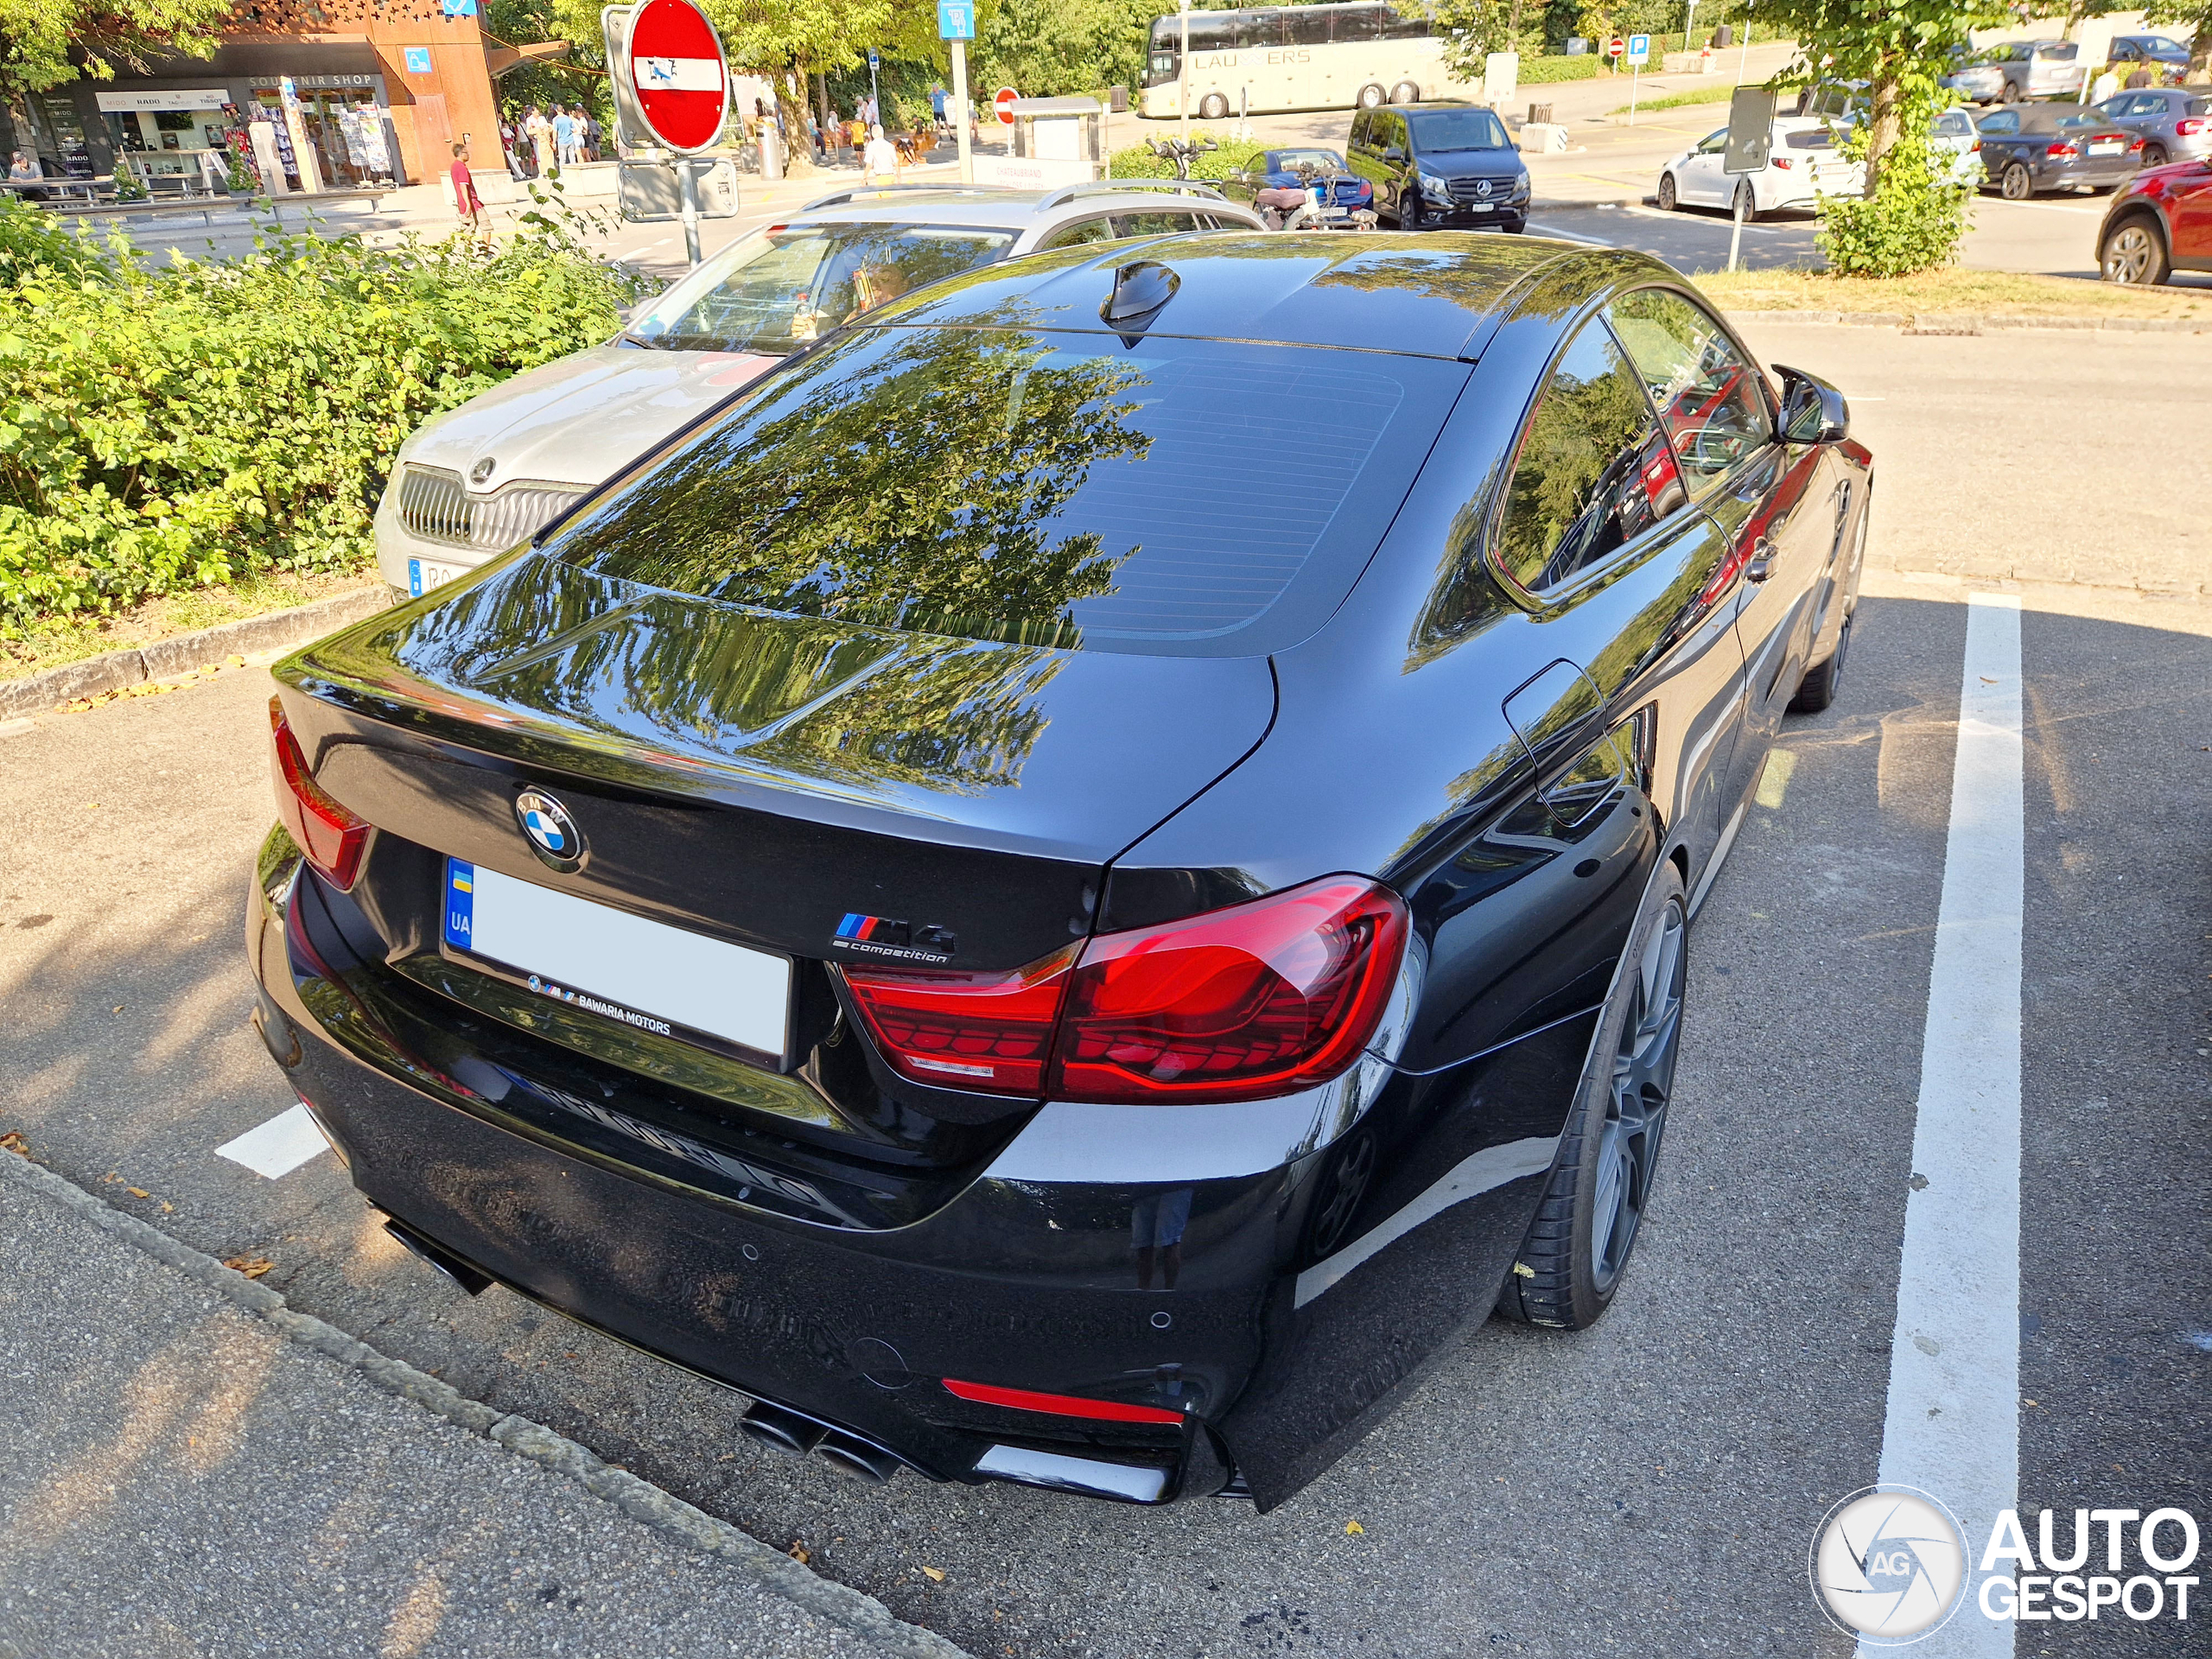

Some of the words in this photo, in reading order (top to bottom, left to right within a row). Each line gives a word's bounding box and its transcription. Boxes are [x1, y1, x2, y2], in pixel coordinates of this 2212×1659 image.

[1633, 38, 1645, 54] P
[249, 76, 326, 86] SOUENIR
[334, 74, 372, 86] SHOP
[518, 796, 565, 824] BMW
[451, 912, 471, 935] UA
[850, 942, 948, 963] competition
[579, 995, 625, 1020] BAWARIA
[626, 1011, 671, 1036] MOTORS
